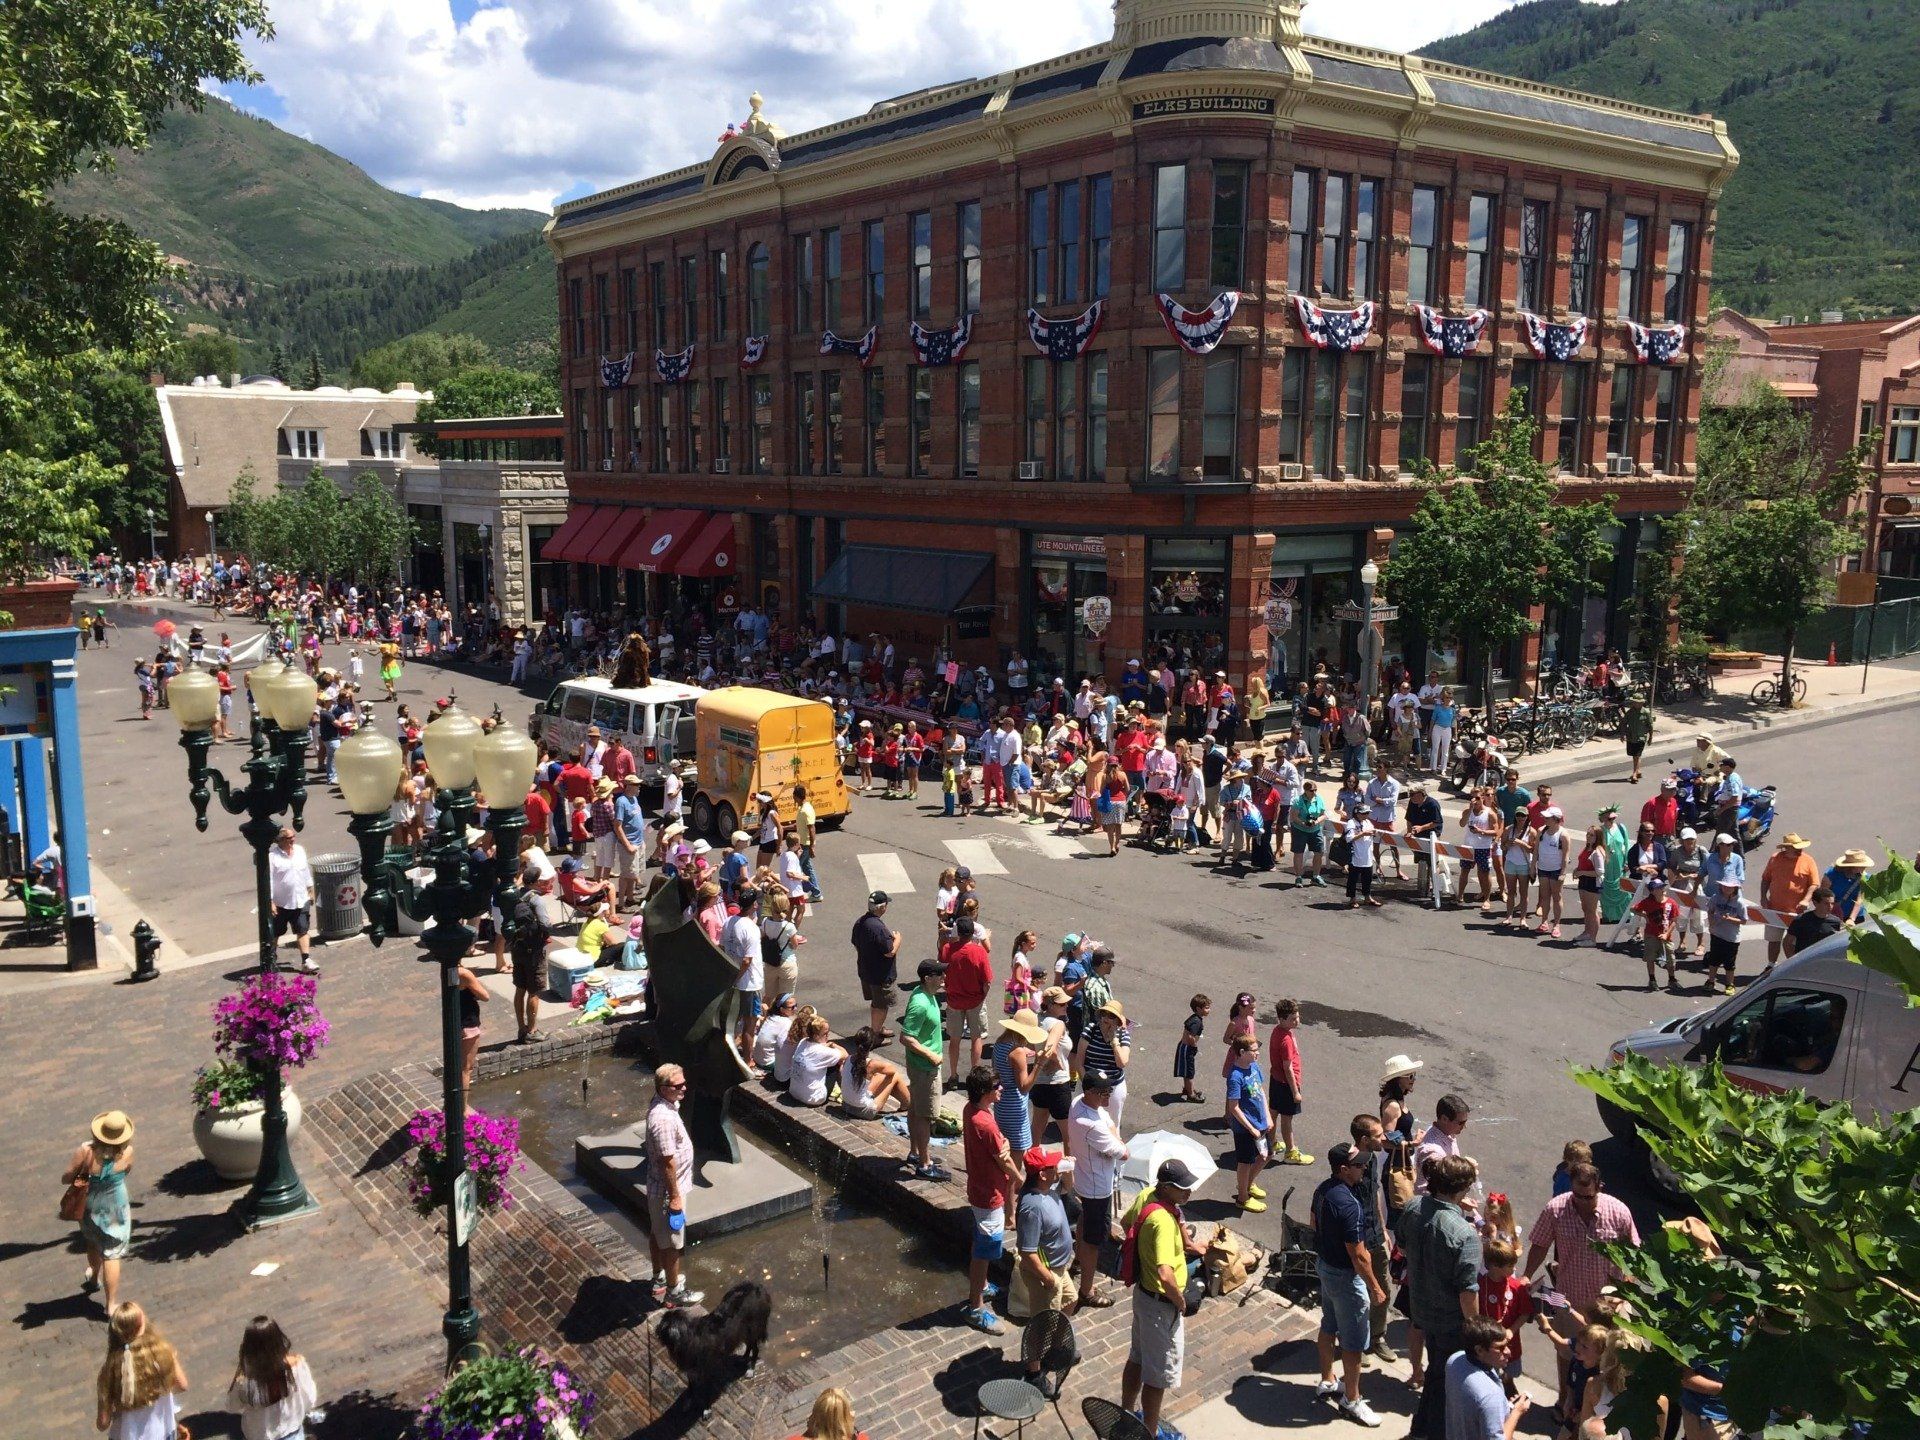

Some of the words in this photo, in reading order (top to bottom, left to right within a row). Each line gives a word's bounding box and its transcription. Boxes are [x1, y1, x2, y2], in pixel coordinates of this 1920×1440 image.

[1143, 100, 1187, 115] ELKS
[1189, 98, 1268, 111] BUILDING
[1037, 541, 1051, 549] UTE
[1052, 542, 1106, 554] MOUNTAINEER
